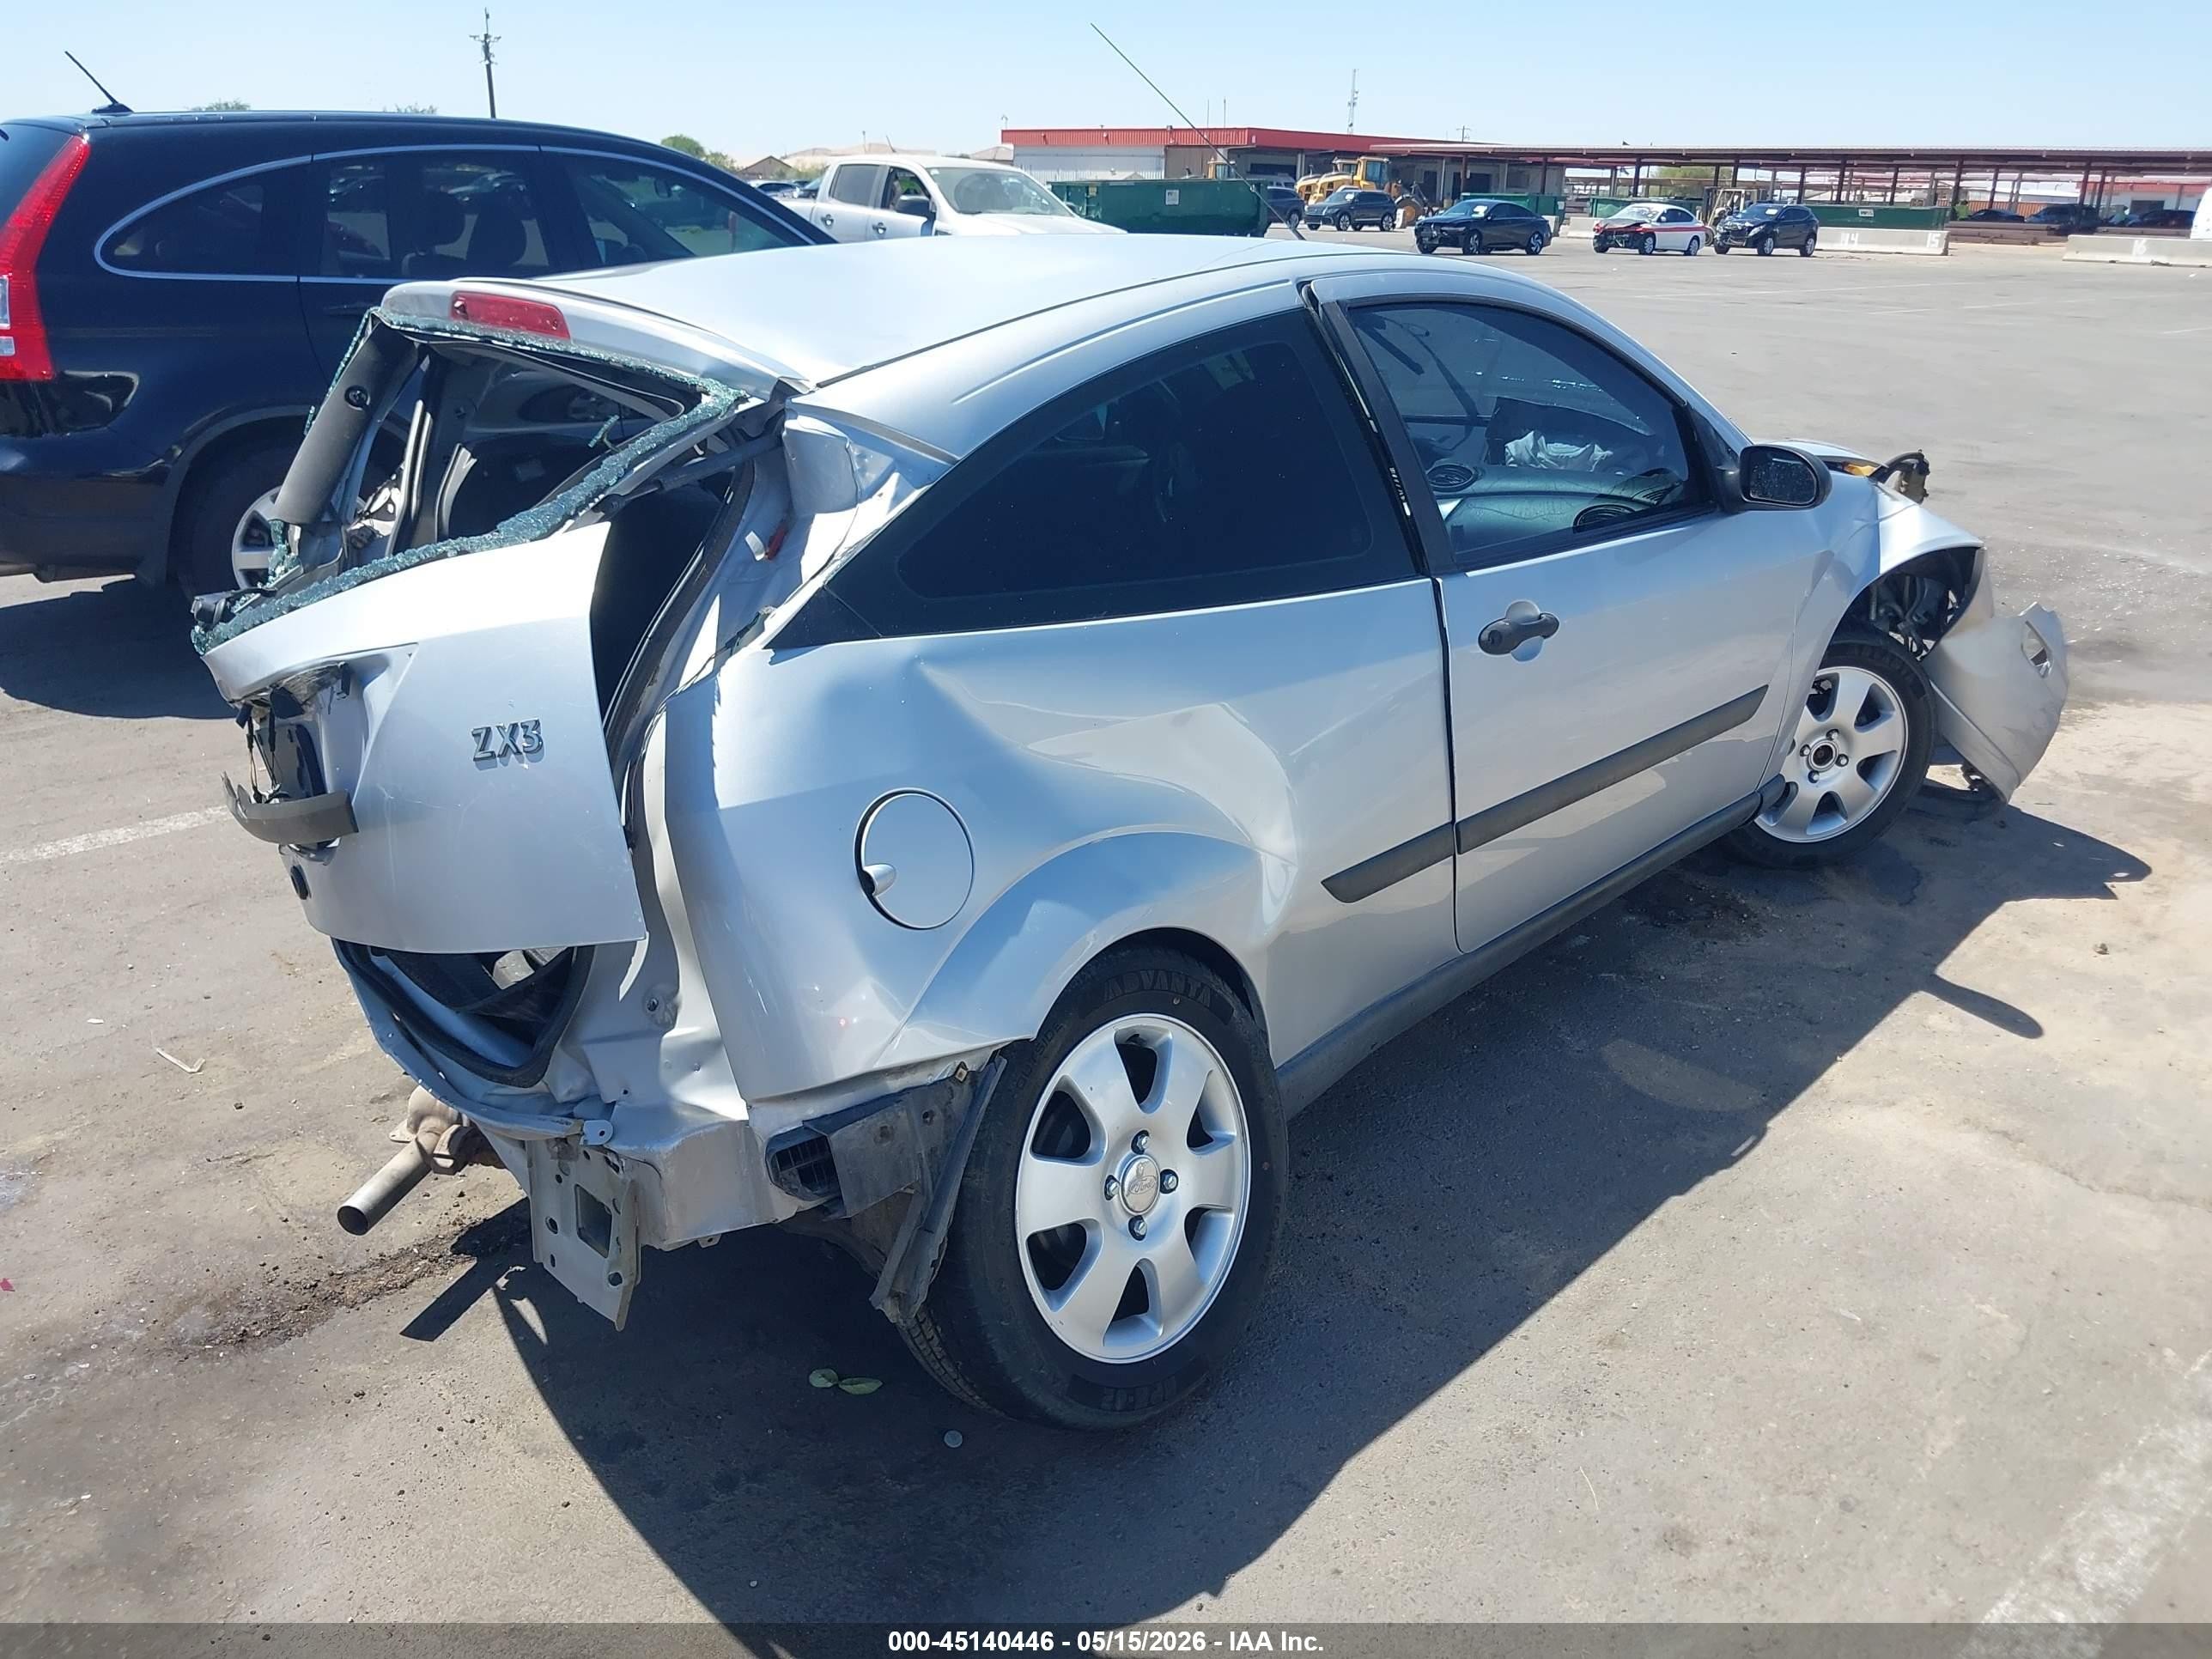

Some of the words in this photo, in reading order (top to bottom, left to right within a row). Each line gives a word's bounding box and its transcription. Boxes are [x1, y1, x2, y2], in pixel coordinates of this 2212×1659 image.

[1926, 233, 1942, 248] 15
[2132, 239, 2148, 257] 16
[471, 717, 544, 763] ZX3
[1103, 969, 1212, 1008] ADVANTA
